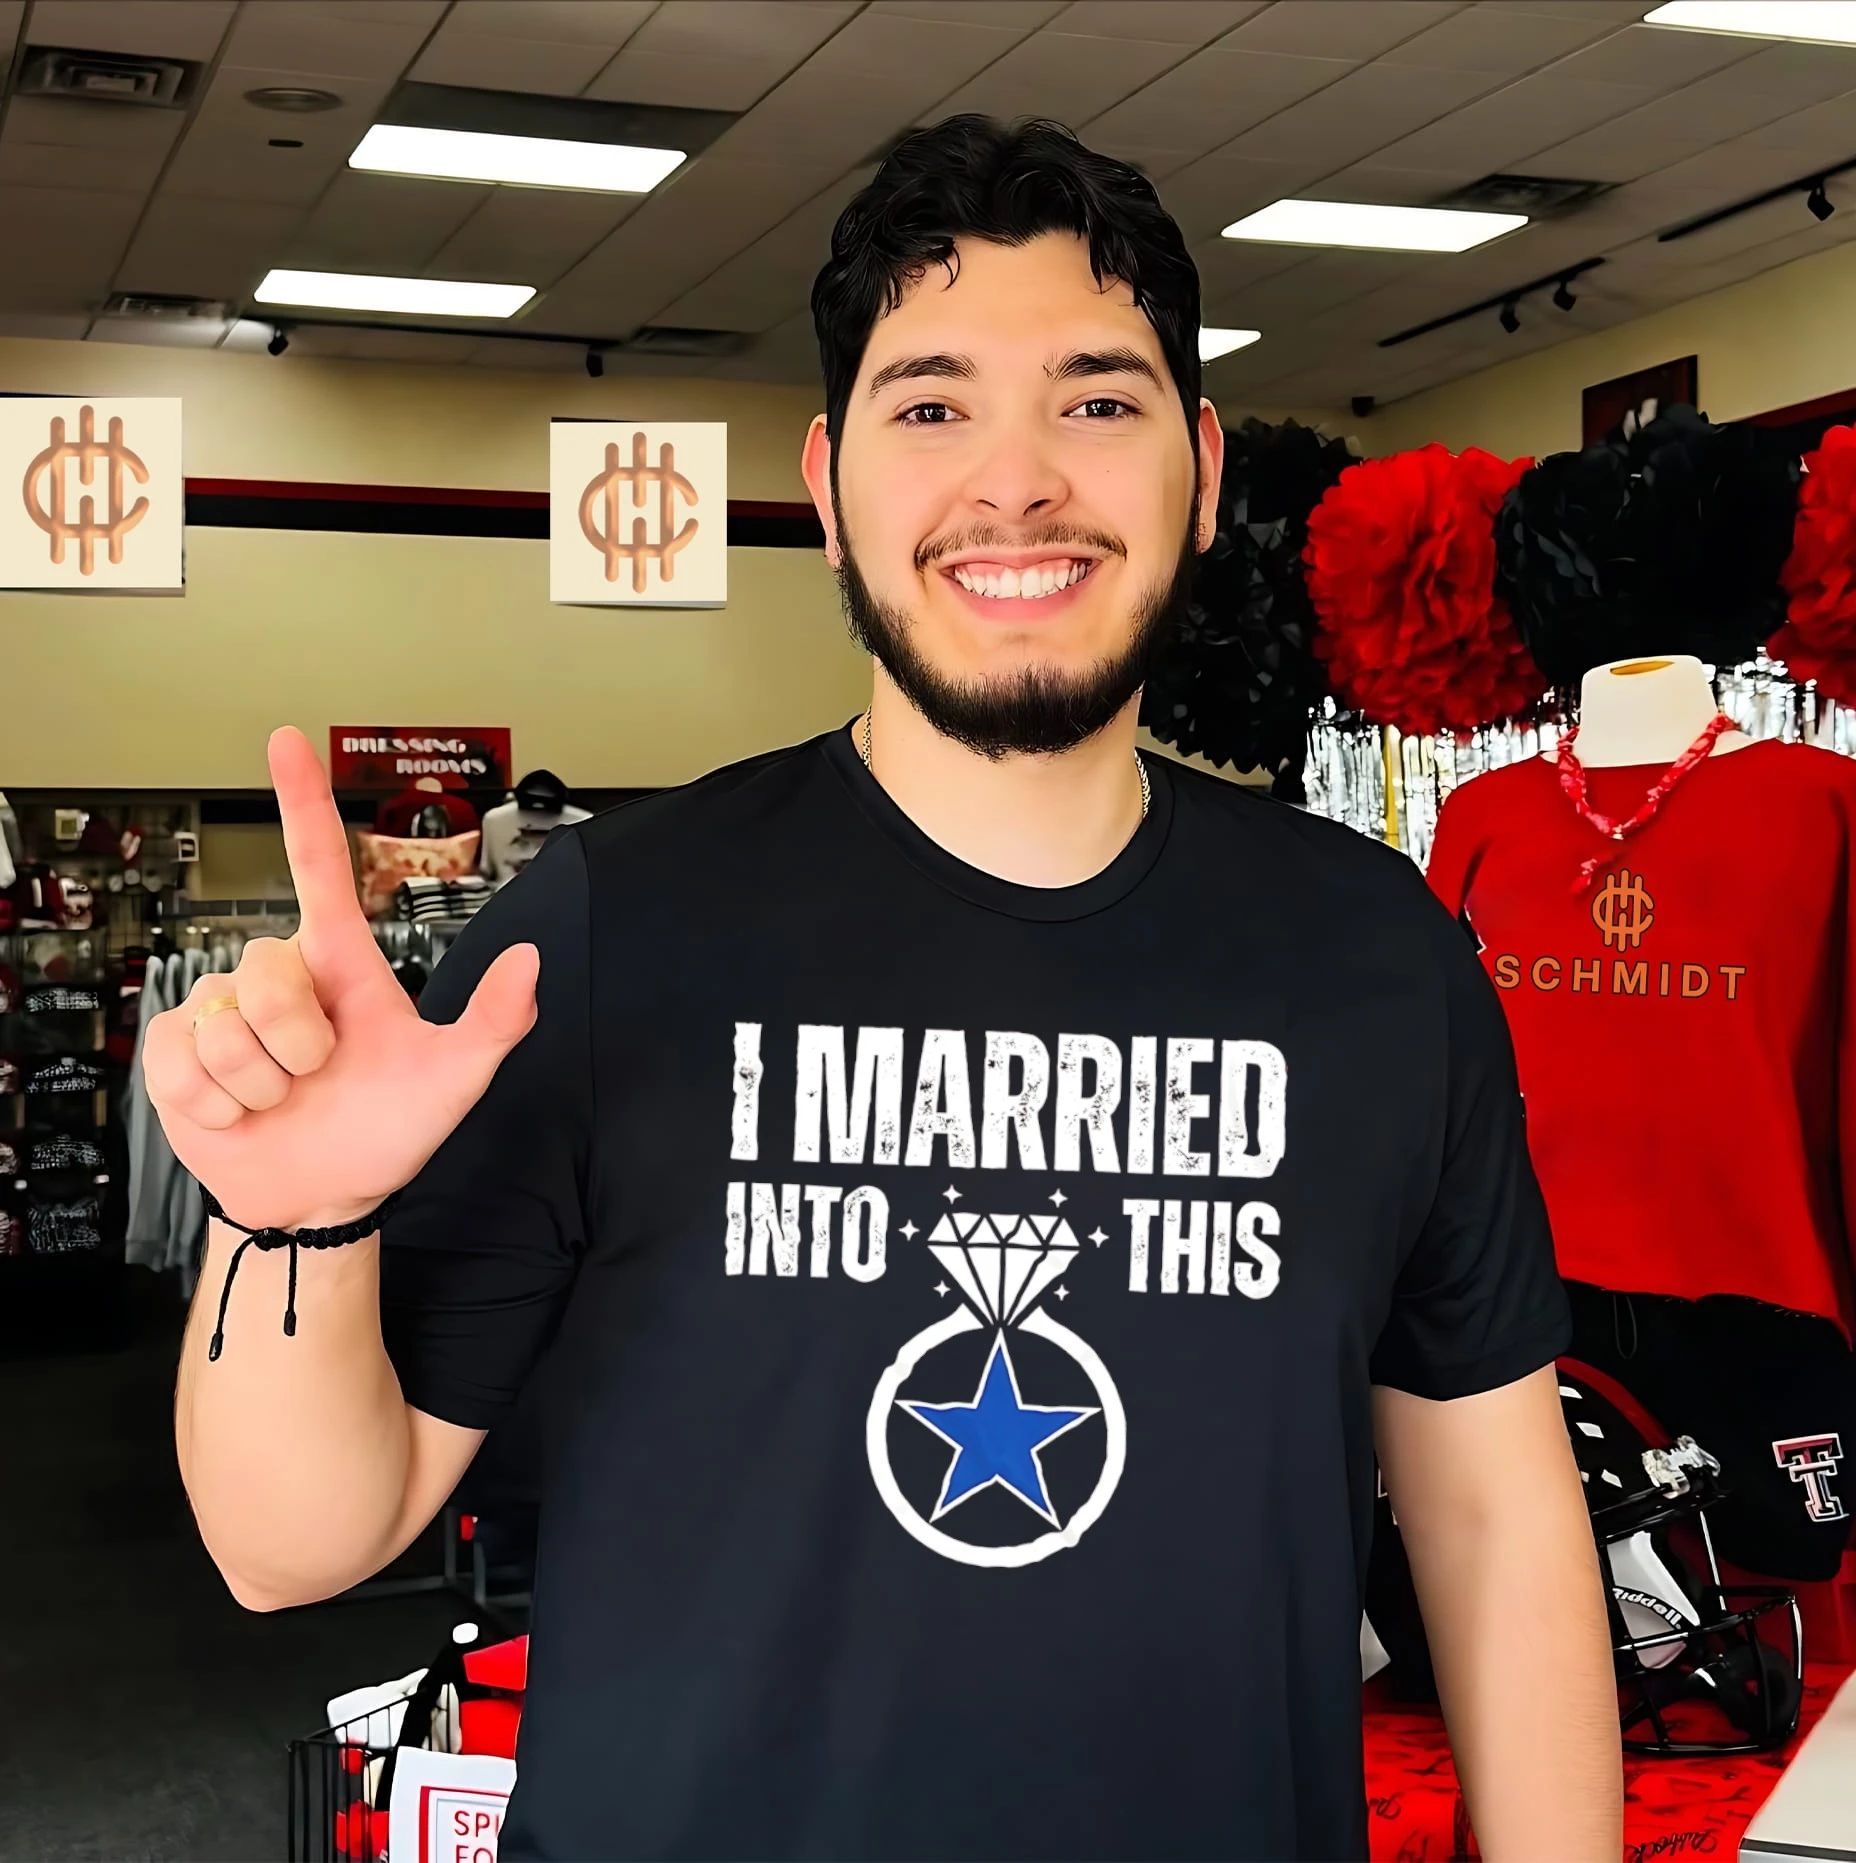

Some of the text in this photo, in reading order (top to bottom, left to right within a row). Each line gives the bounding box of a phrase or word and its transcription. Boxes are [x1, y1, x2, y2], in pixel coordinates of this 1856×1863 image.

[1494, 955, 1746, 1000] SCHMIDT
[729, 1021, 1289, 1179] I MARRIED
[724, 1181, 1282, 1300] INTO THIS
